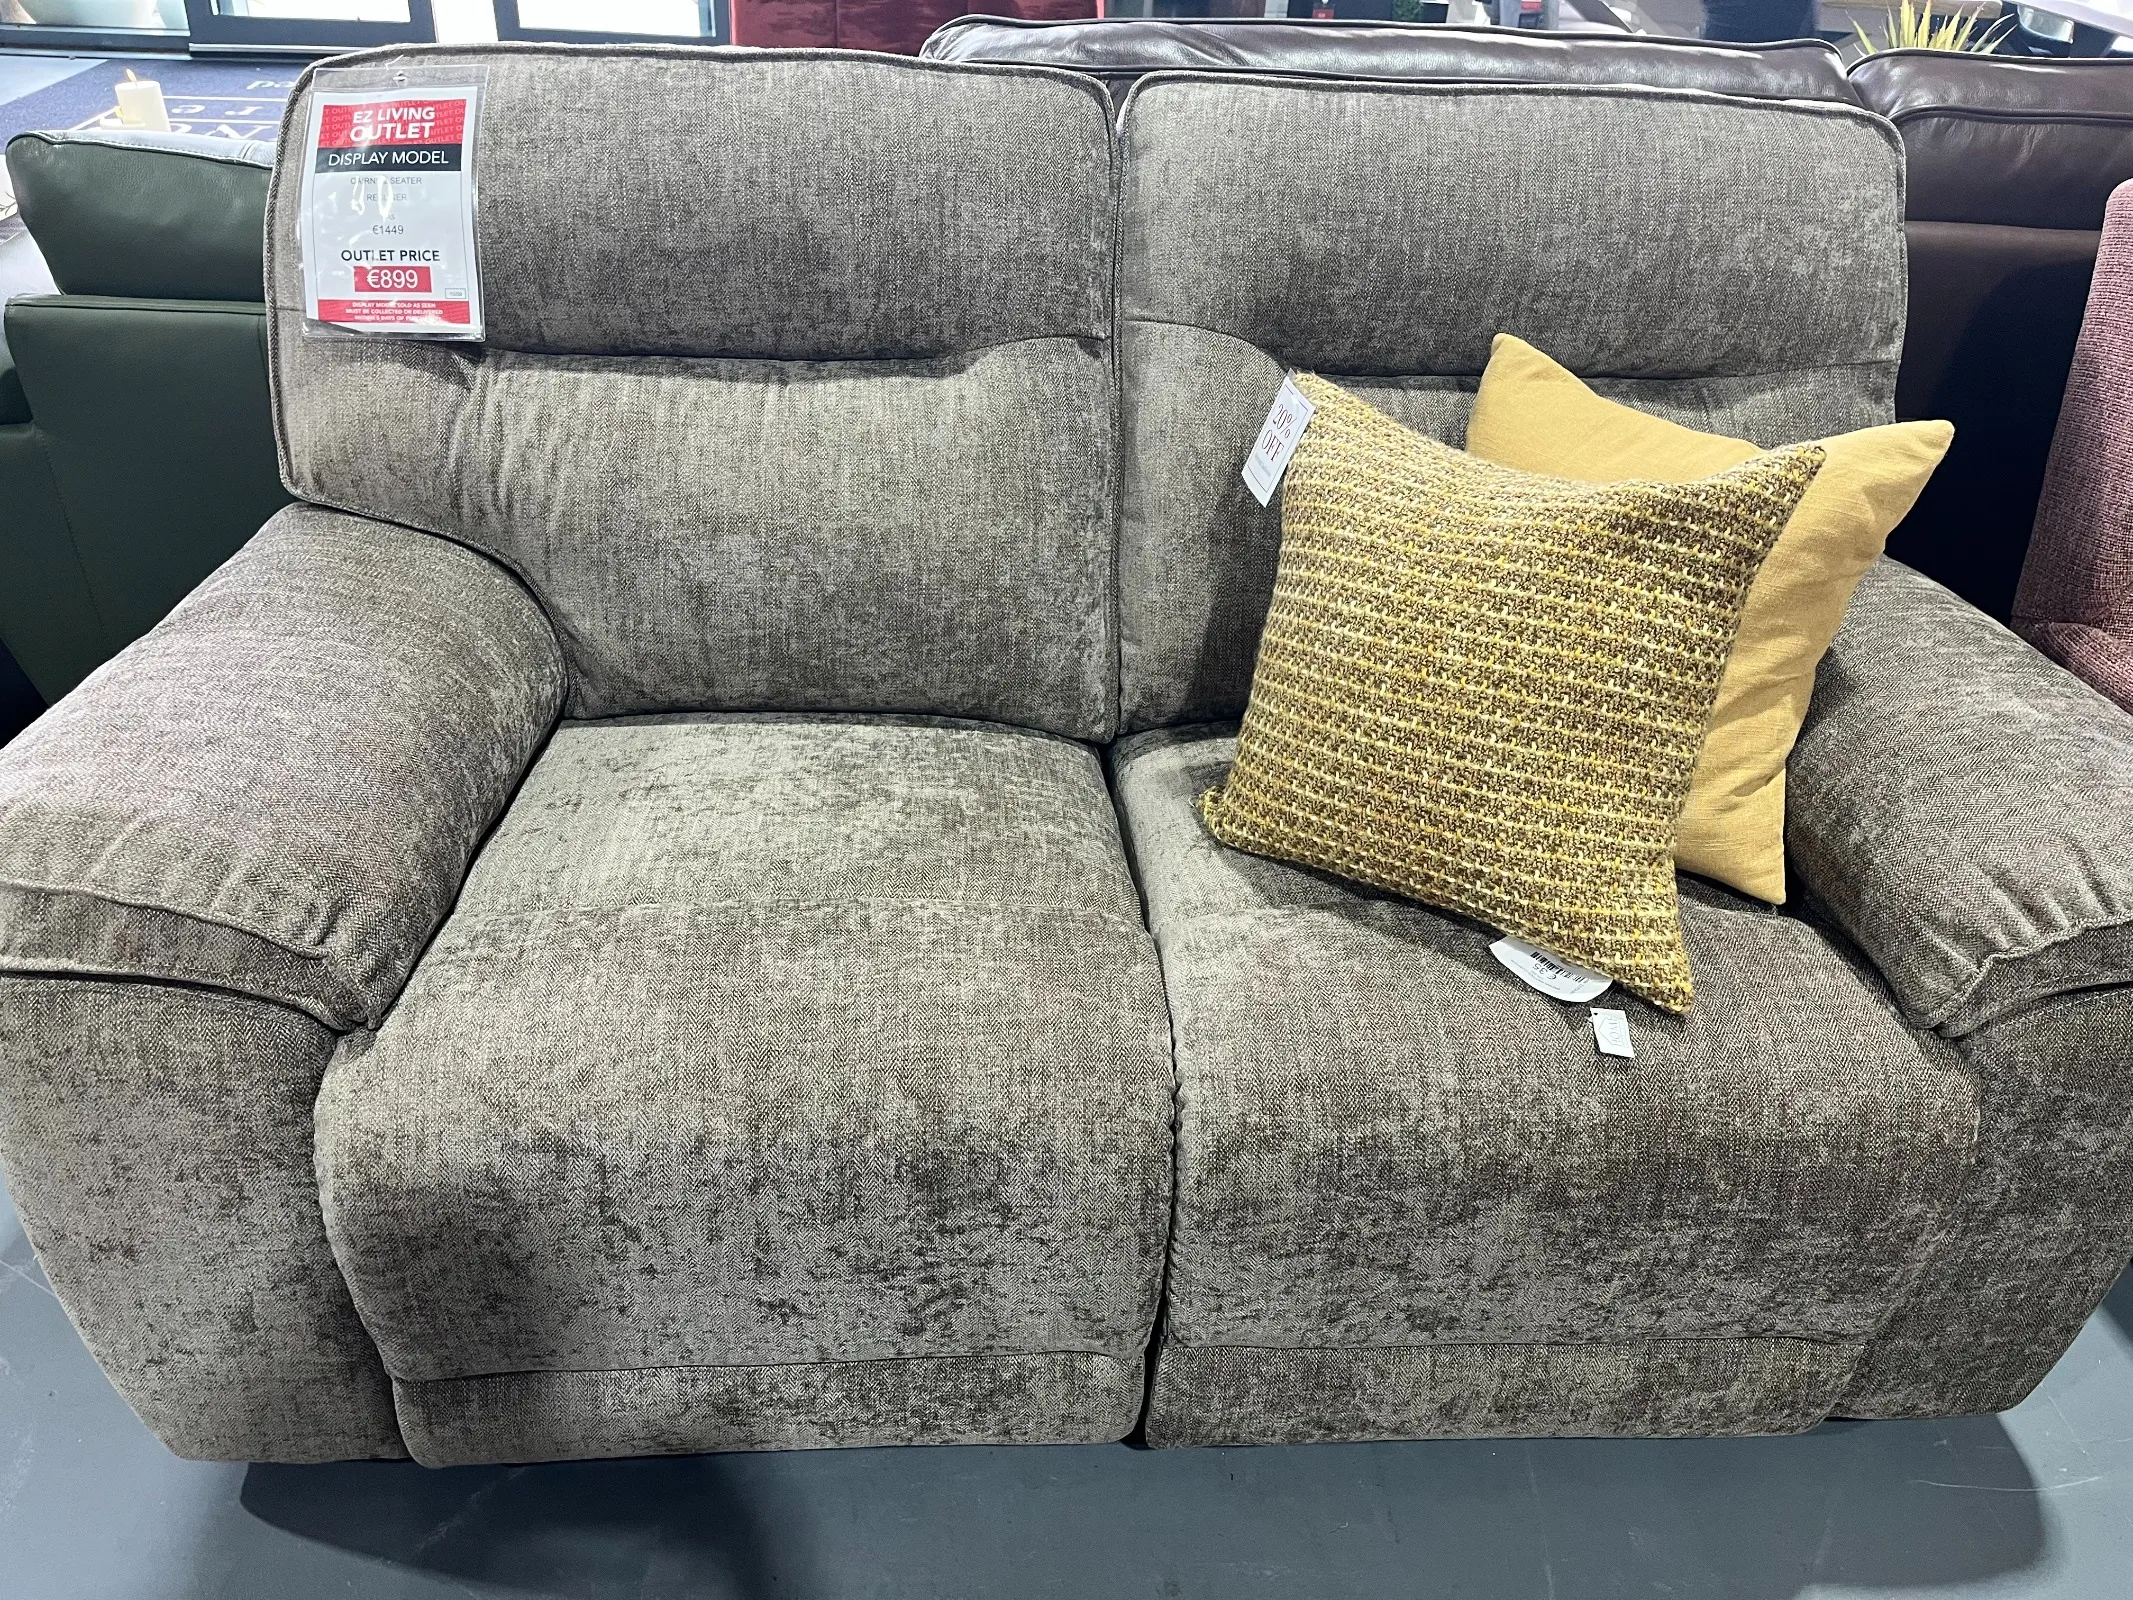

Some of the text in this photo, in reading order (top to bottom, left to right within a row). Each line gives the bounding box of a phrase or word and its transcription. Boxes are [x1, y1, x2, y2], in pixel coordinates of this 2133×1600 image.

[353, 110, 373, 123] EZ
[377, 107, 435, 121] LIVING
[349, 122, 435, 141] OUTLET
[328, 151, 449, 166] DISPLAY MODEL
[372, 225, 404, 235] €1449
[341, 249, 440, 262] OUTLET PRICE
[366, 269, 418, 289] €899
[1273, 404, 1297, 438] 20%
[1262, 430, 1284, 461] OFF
